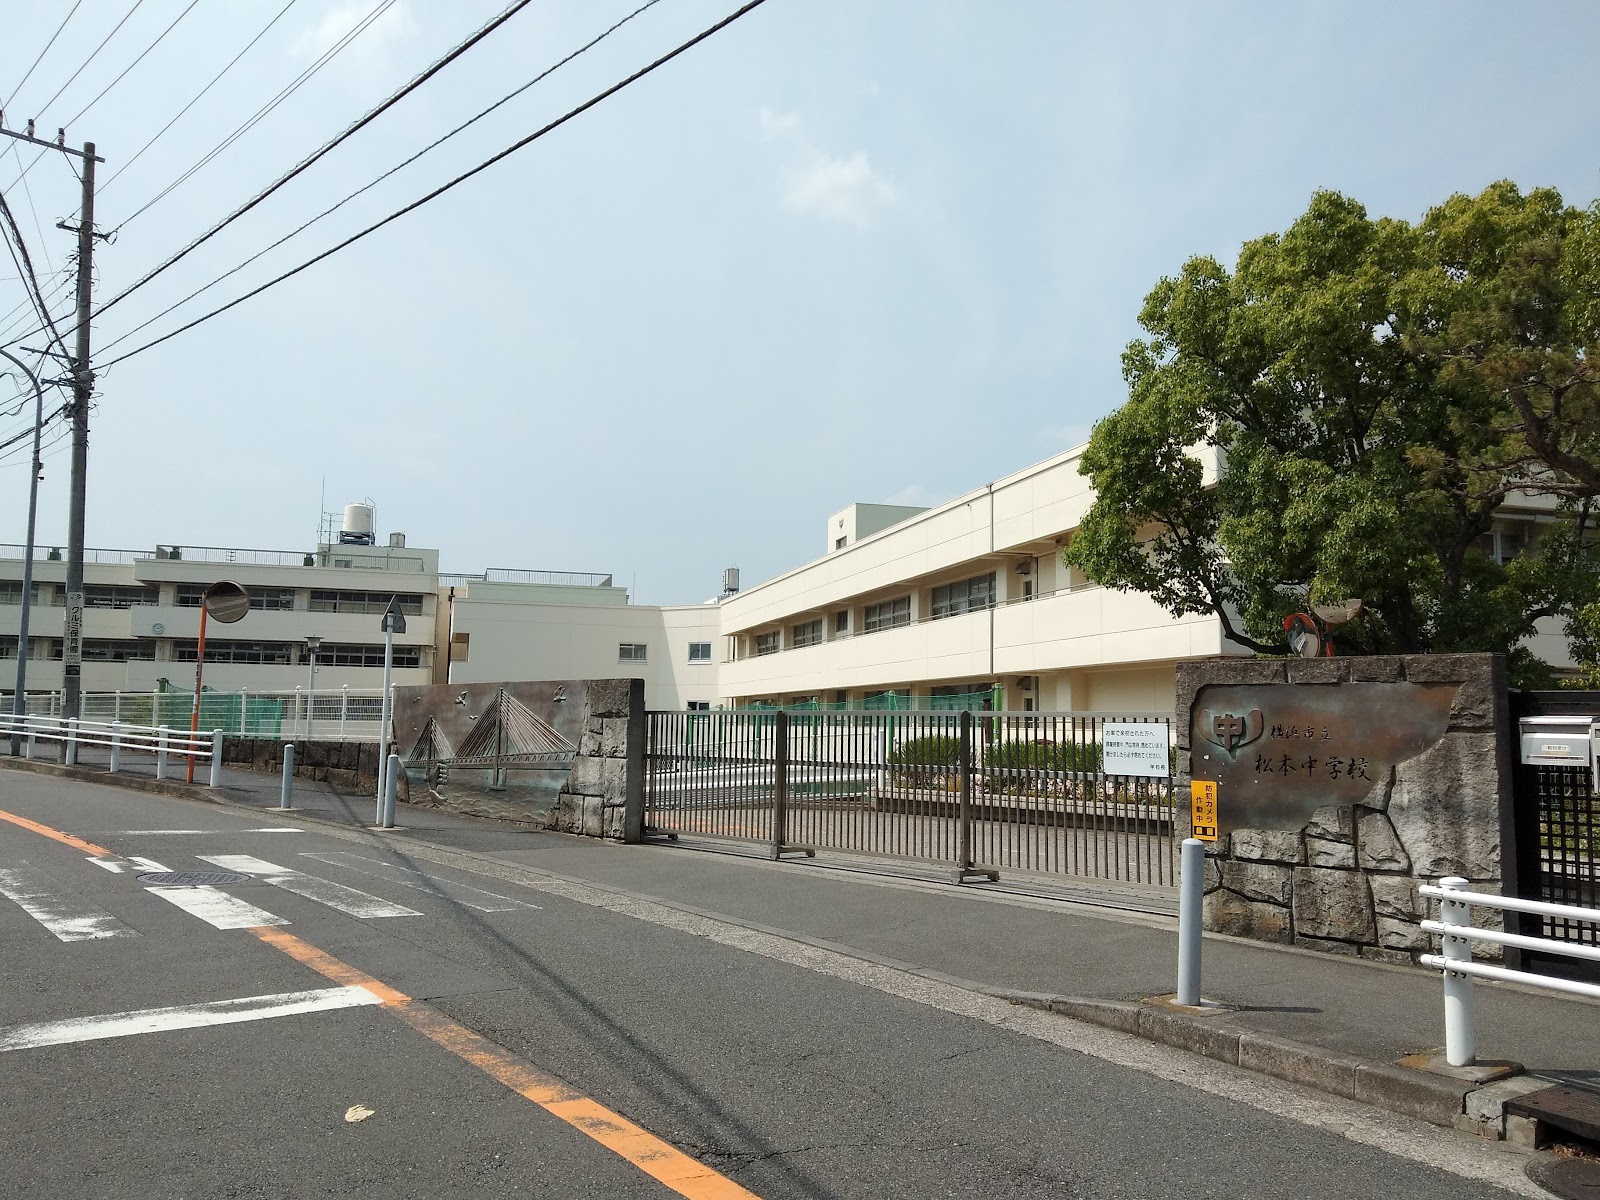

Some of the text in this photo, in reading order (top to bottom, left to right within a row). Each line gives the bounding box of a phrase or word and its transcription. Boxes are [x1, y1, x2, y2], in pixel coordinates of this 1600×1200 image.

[1270, 724, 1333, 741] 横浜市立
[1254, 754, 1372, 782] 松本中学校
[1205, 784, 1213, 823] 防犯カメラ
